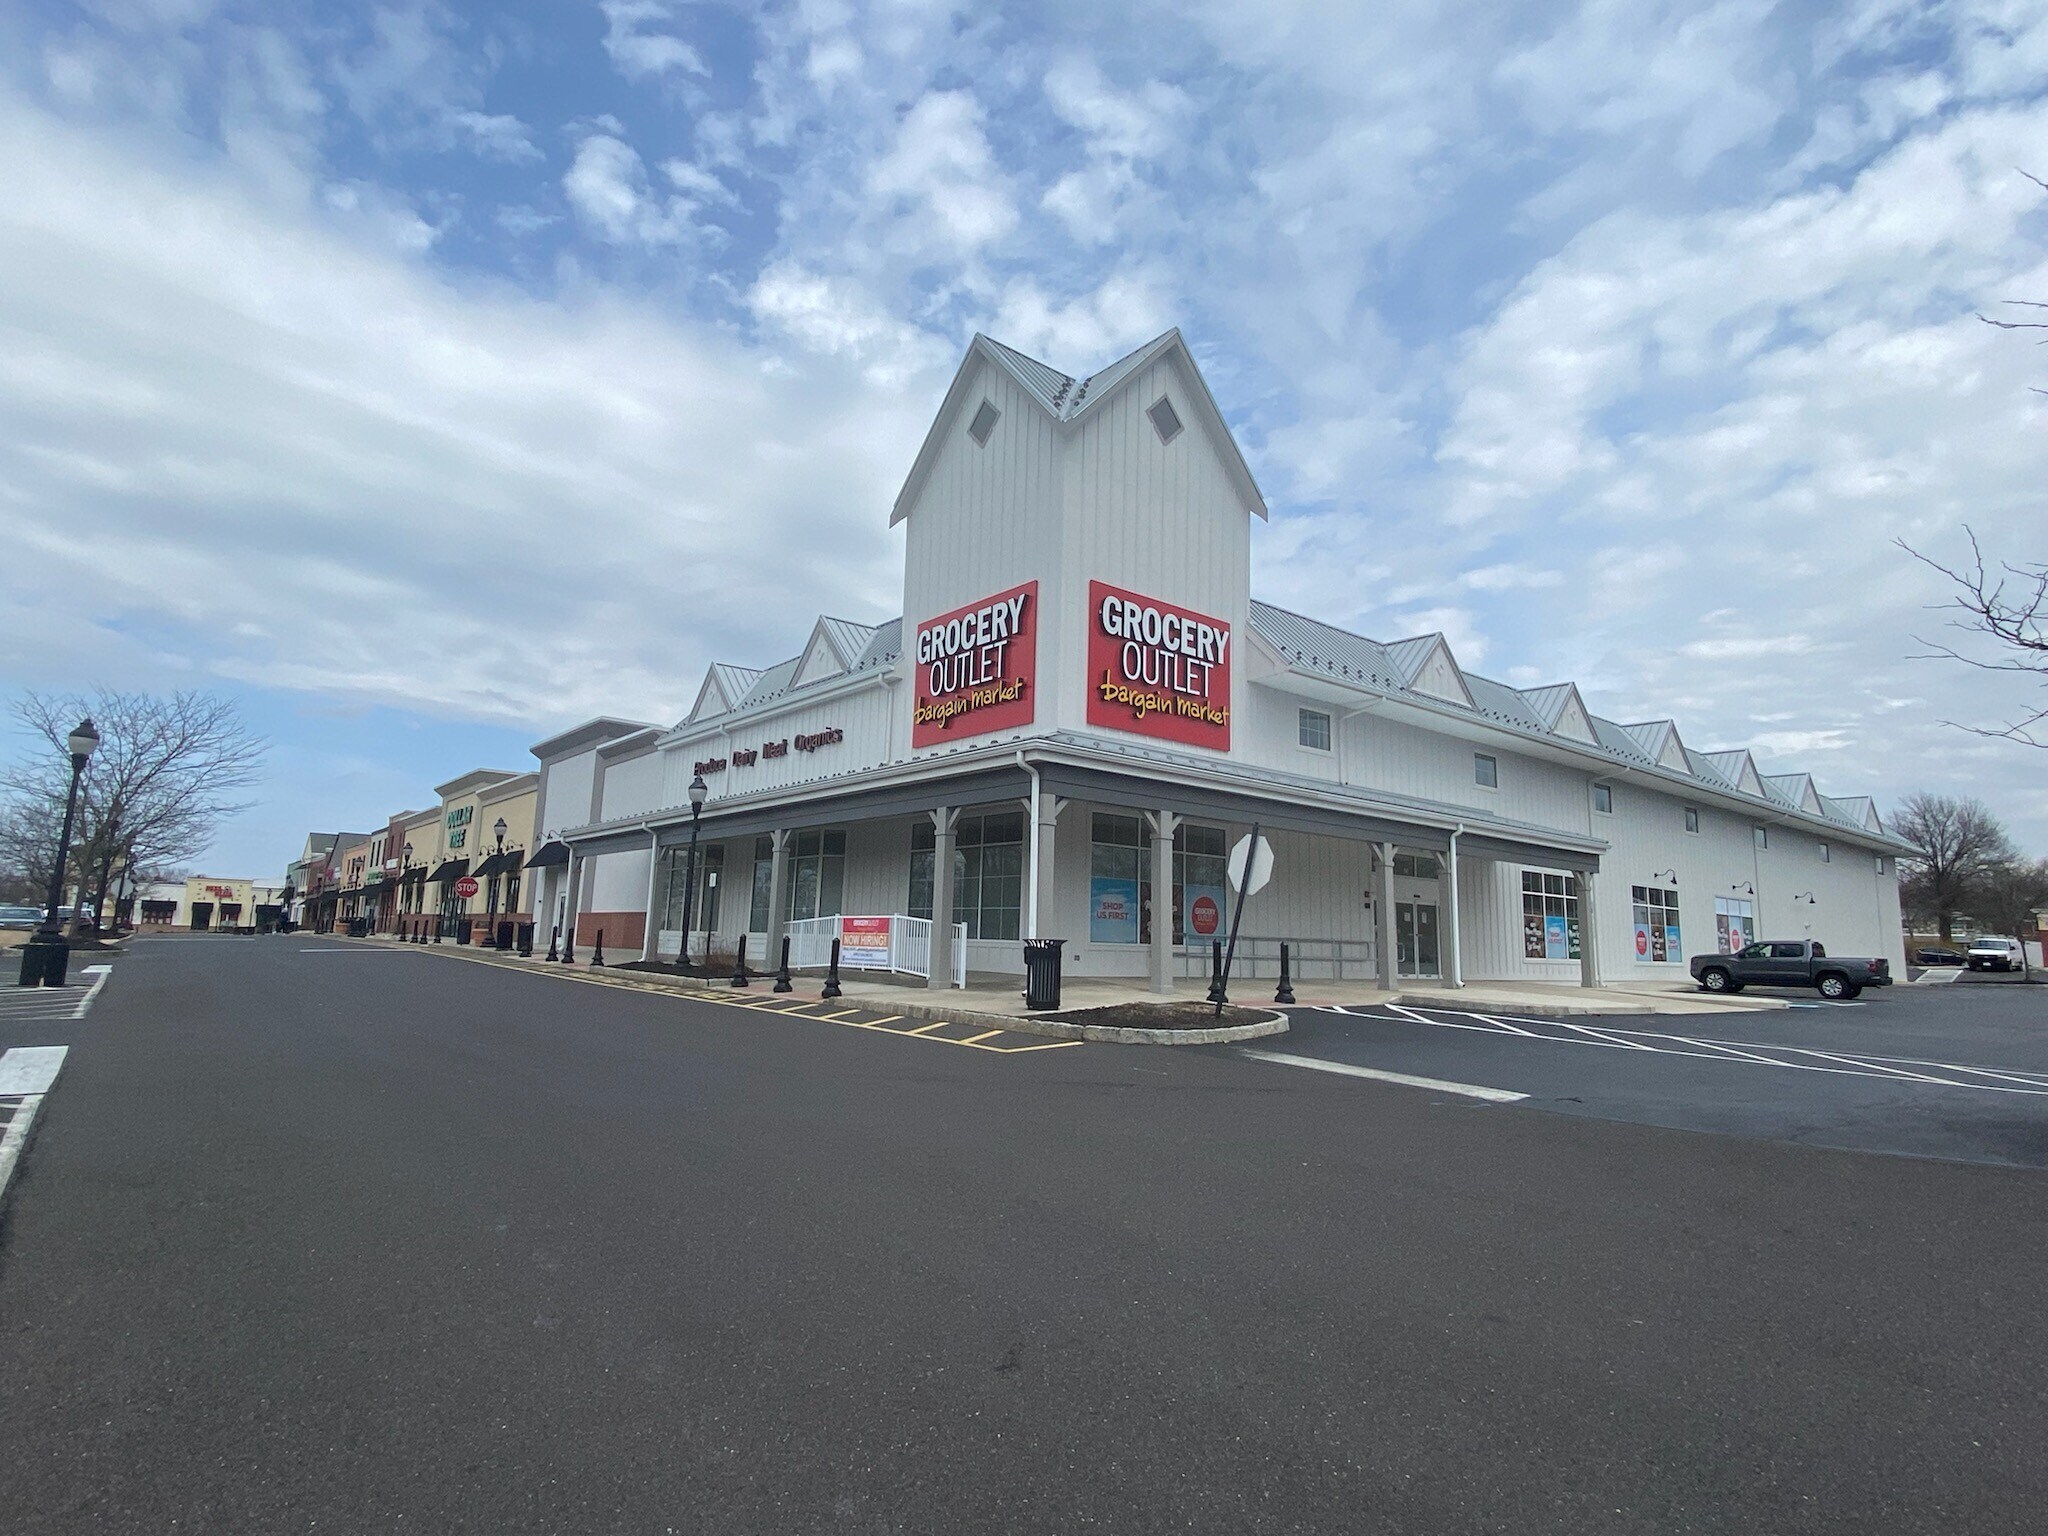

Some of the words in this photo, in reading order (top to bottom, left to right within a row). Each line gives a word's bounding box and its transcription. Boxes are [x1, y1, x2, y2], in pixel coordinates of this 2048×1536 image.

[917, 593, 1026, 665] GROCERY
[1102, 595, 1229, 665] GROCERY
[929, 640, 1008, 697] OUTLET
[1122, 641, 1214, 698] OUTLET
[914, 697, 967, 728] bargain
[971, 678, 1023, 709] market
[1100, 669, 1172, 719] bargain
[1177, 695, 1229, 726] market
[762, 738, 788, 759] Meat
[794, 726, 843, 753] Organics
[447, 806, 473, 828] DOLLAR
[450, 827, 466, 848] TREE
[457, 883, 478, 892] STOP
[1096, 911, 1108, 920] US
[1108, 911, 1129, 920] FIRST
[1102, 902, 1124, 911] SHOP
[843, 934, 860, 945] NOW
[860, 934, 887, 946] HIRING!
